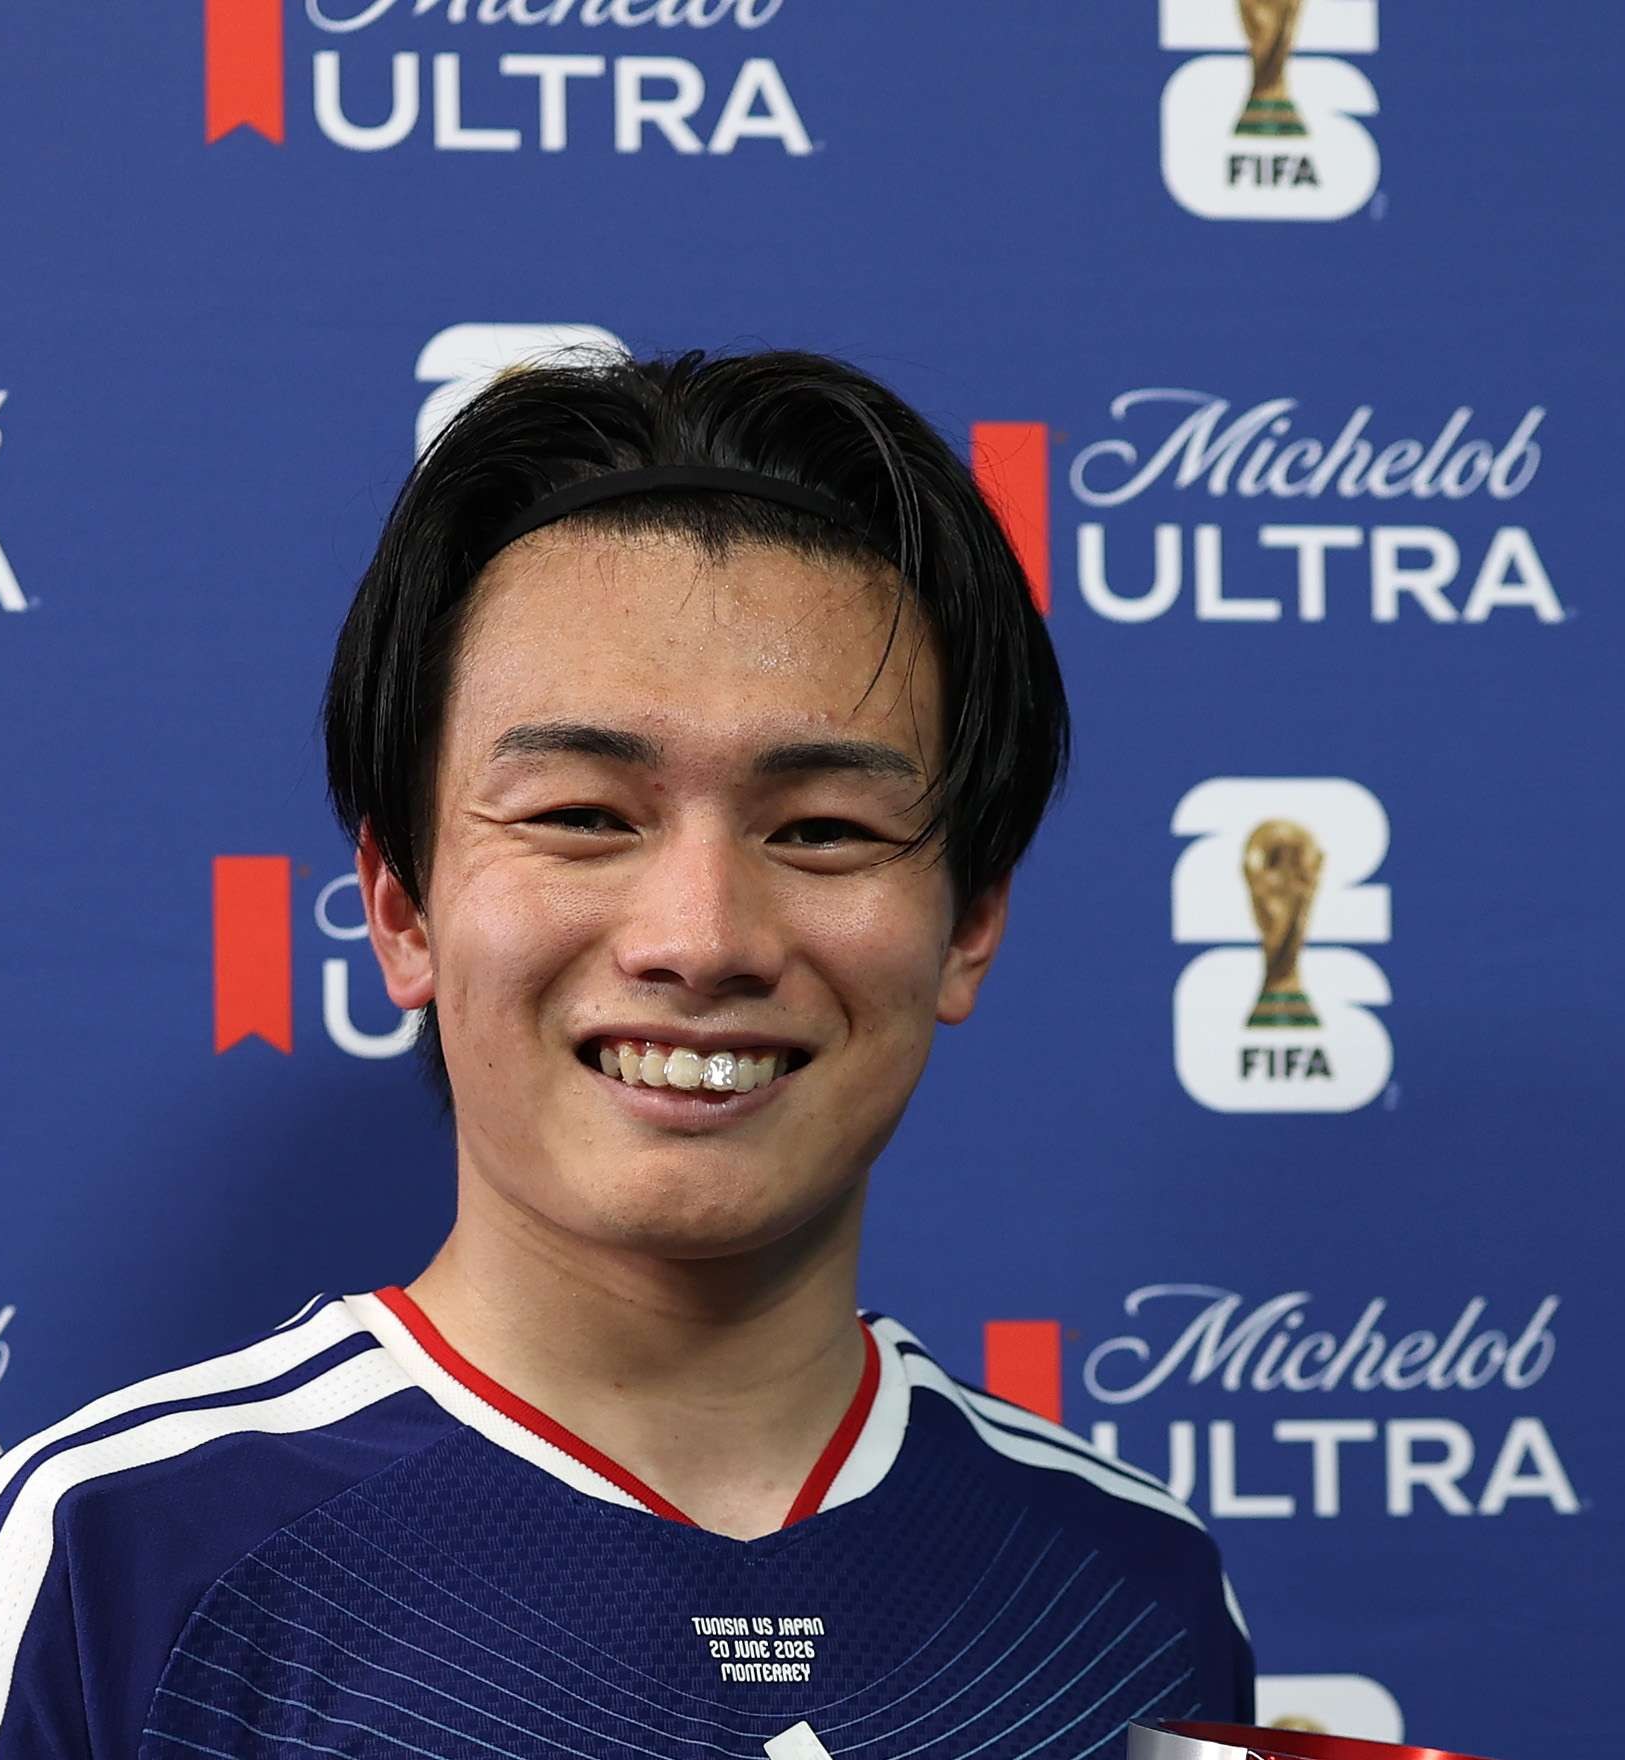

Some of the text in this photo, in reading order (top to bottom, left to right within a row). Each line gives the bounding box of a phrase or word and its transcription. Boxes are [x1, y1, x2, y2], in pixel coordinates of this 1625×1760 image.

[314, 51, 812, 154] ULTRA
[1229, 155, 1317, 185] FIFA
[1070, 389, 1545, 507] Michelob
[1078, 524, 1564, 622] ULTRA
[1241, 1048, 1331, 1079] FIFA
[1084, 1285, 1558, 1404] Michelob
[691, 1617, 749, 1635] TUNISIA
[778, 1617, 825, 1636] JAPAN
[709, 1640, 815, 1659] 20 JUNE 2026
[721, 1663, 811, 1682] MONTERREY
